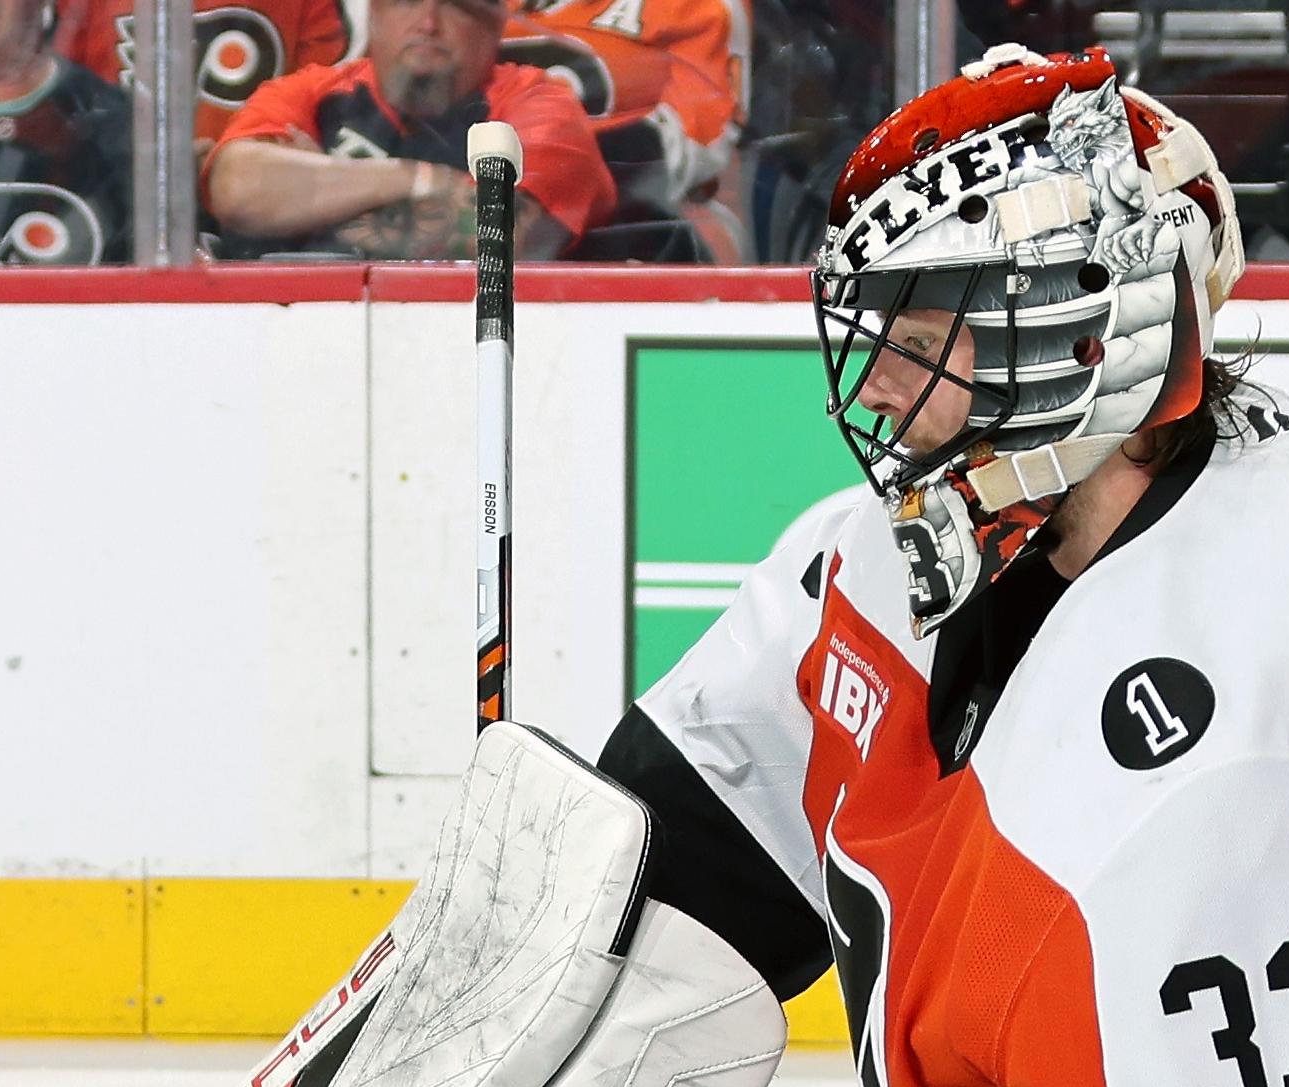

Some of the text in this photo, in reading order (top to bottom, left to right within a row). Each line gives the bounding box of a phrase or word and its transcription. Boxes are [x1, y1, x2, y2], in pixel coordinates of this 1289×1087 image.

[484, 482, 498, 536] ERSSON
[819, 651, 883, 763] IBX
[1126, 672, 1189, 756] 1
